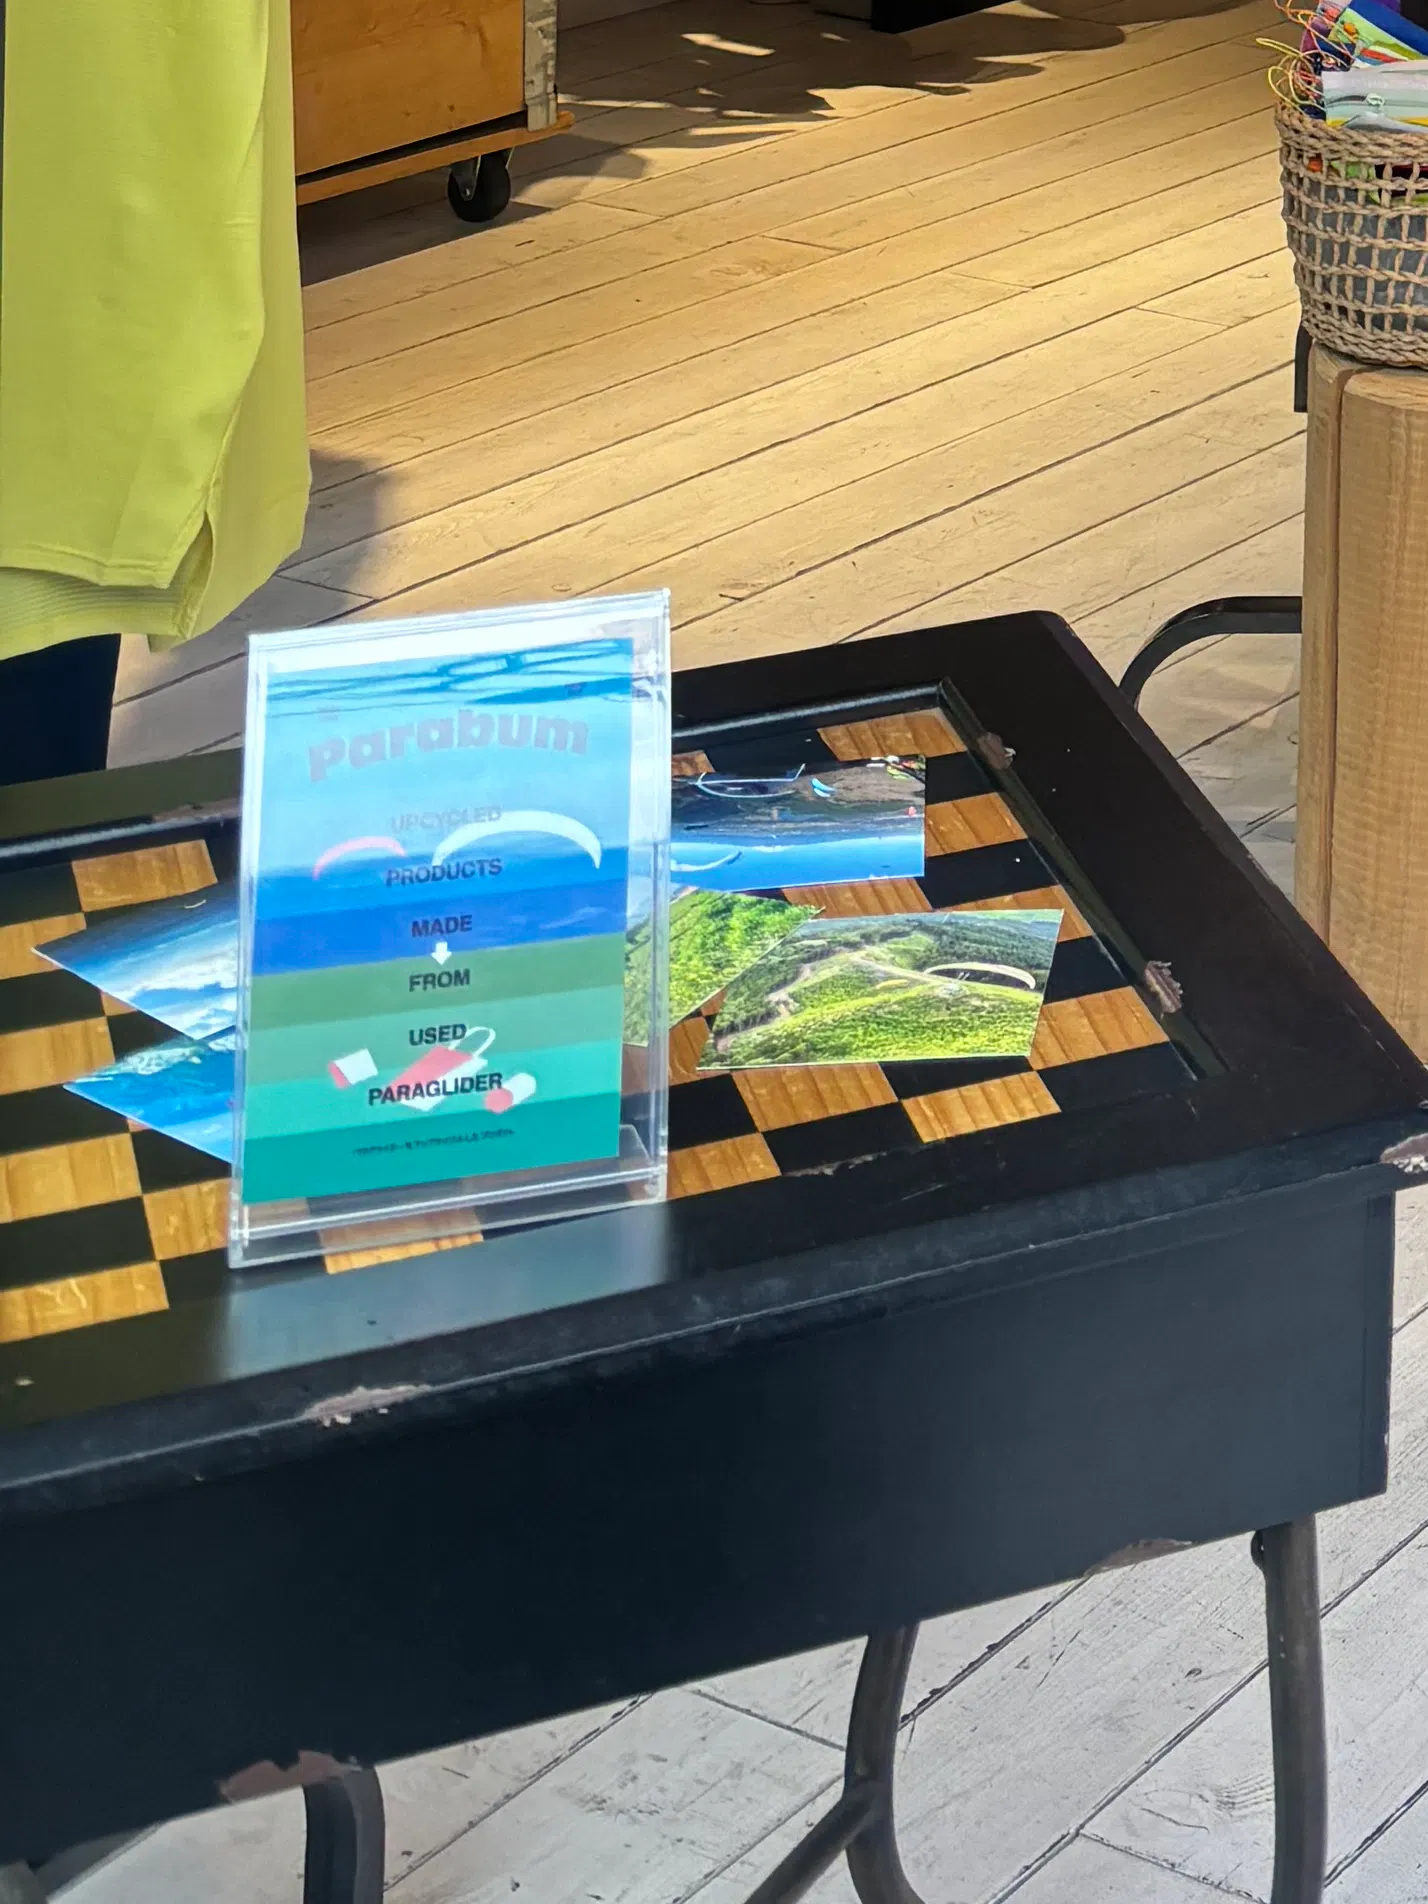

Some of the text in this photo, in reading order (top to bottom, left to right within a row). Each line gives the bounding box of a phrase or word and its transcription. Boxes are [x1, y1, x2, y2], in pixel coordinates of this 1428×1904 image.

[308, 708, 590, 783] parabum
[390, 805, 502, 833] UPCYCLED
[385, 857, 503, 888] PRODUCTS
[411, 914, 473, 938] MADE
[408, 968, 471, 992] FROM
[409, 1023, 467, 1046] USED
[368, 1072, 503, 1106] PARAGLIDER
